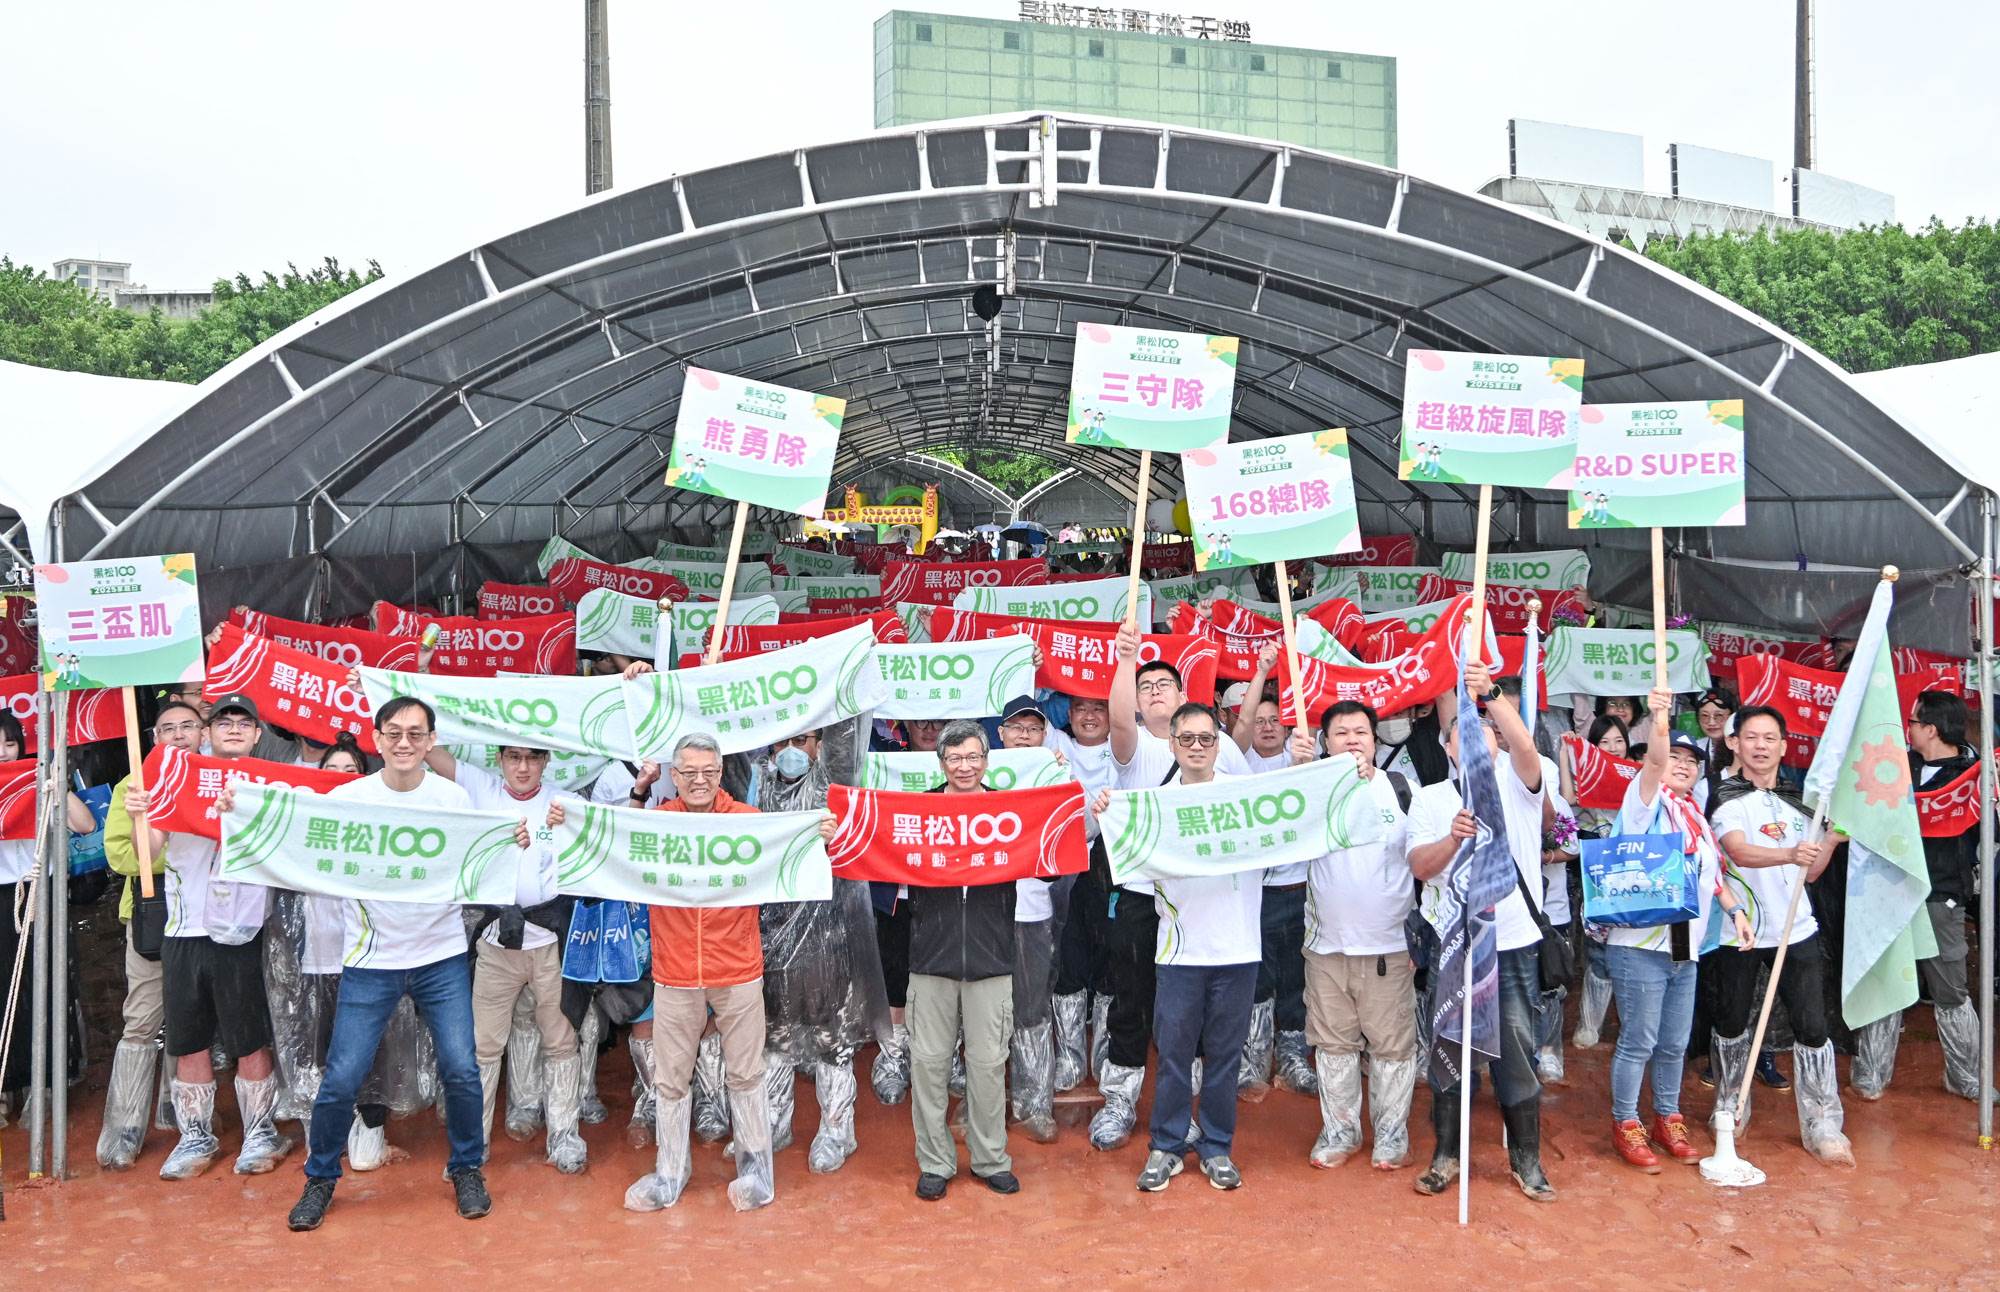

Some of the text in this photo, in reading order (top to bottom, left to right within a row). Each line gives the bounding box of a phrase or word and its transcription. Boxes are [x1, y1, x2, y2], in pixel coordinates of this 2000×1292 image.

[1099, 372, 1204, 411] 三守隊
[1415, 401, 1566, 438] 超級旋風隊
[702, 416, 807, 468] 熊勇隊
[1574, 452, 1737, 477] R&D SUPER
[1210, 479, 1331, 521] 168總隊
[93, 565, 137, 579] 黑松100
[584, 566, 653, 595] 黑松100
[924, 568, 1001, 588] 黑松100
[480, 592, 555, 614] 黑松100
[1007, 596, 1098, 620] 黑松100
[68, 602, 172, 642] 三盃肌
[435, 628, 525, 651] 黑松100
[1051, 631, 1161, 667] 黑松10
[1582, 641, 1680, 665] 黑松100
[269, 661, 373, 719] 黑松100
[697, 664, 818, 716] 黑松100
[276, 697, 363, 735] 轉動·感動
[715, 702, 810, 733] 轉動·感動
[1175, 788, 1306, 838] 黑松100
[304, 816, 446, 859] 黑松100
[892, 811, 1022, 846] 黑松100
[1195, 830, 1298, 857] 轉動·感動
[628, 831, 762, 867] 黑松100
[906, 851, 1009, 868] 轉動·感動
[1616, 841, 1645, 855] FIN
[316, 858, 427, 881] 轉動·感動
[642, 872, 748, 888] 轉動·感動
[570, 927, 599, 945] FIN
